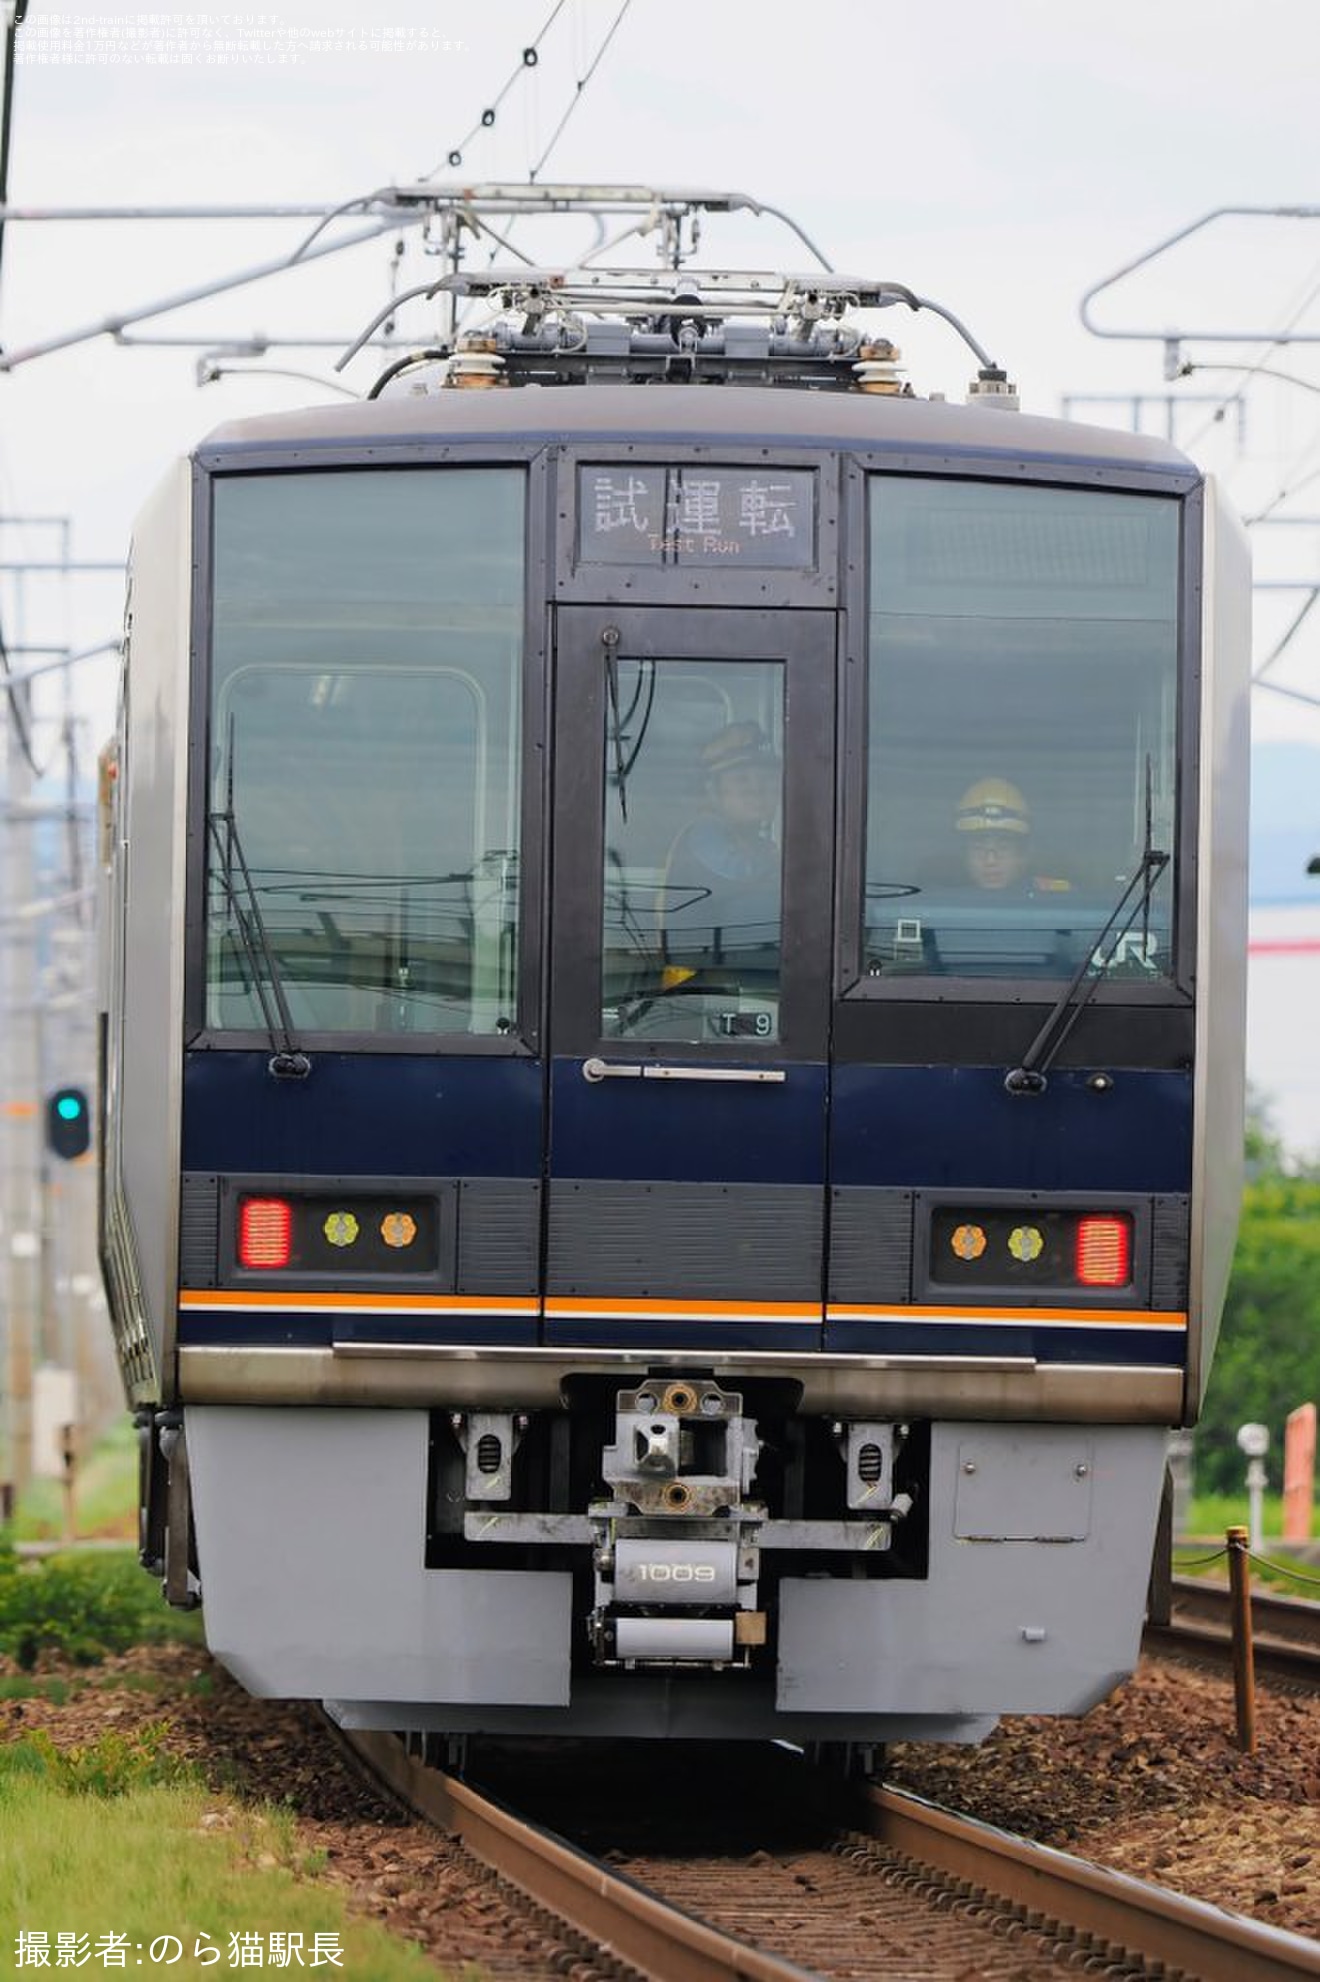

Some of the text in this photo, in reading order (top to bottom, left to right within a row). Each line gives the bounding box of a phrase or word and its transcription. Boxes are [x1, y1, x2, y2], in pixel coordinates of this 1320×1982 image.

[594, 475, 796, 538] 試運転
[647, 533, 740, 554] Test Run
[722, 1013, 771, 1035] T 9
[638, 1563, 716, 1583] 1009
